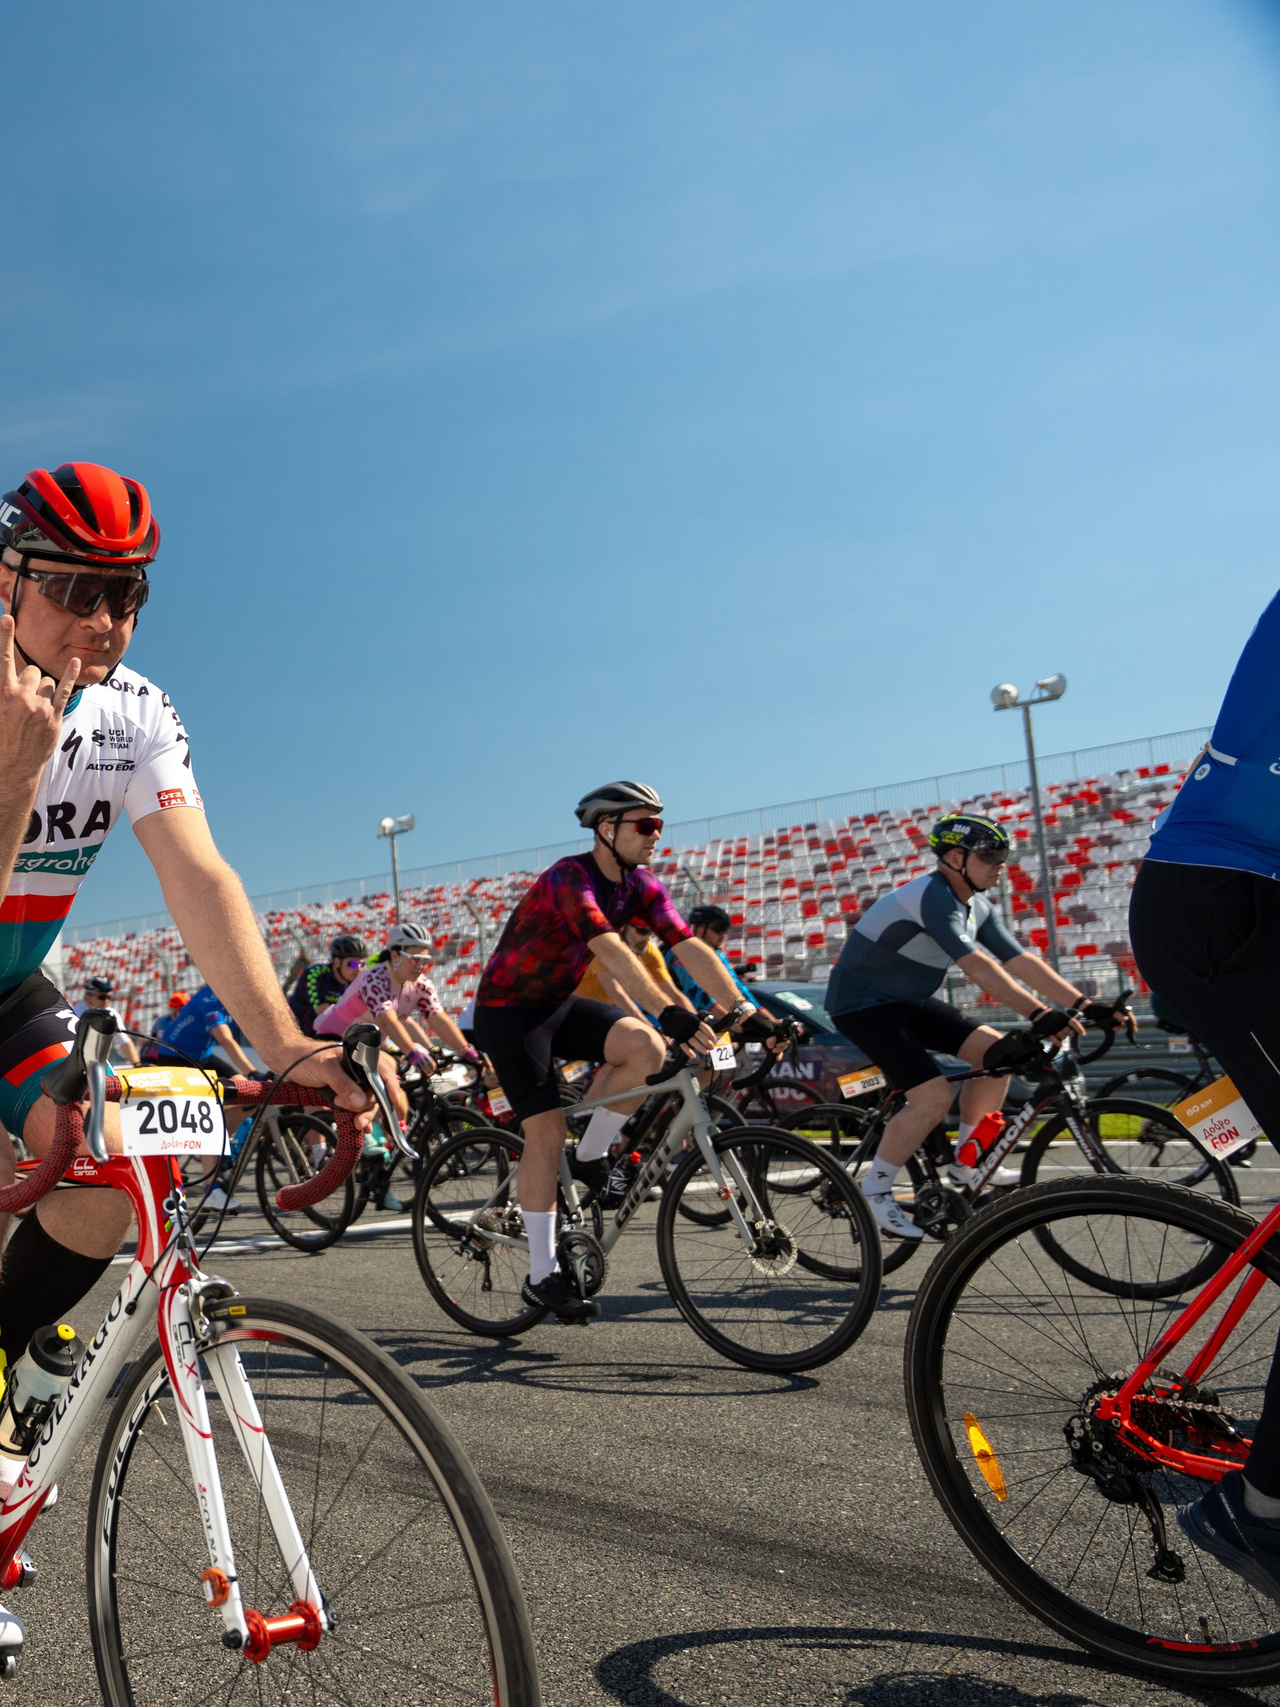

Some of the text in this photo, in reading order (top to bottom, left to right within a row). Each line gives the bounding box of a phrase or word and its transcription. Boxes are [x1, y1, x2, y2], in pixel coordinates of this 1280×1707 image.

[99, 678, 150, 697] ORA
[160, 791, 184, 800] ÖTZ
[162, 798, 185, 806] TAL
[21, 799, 111, 845] ORA
[136, 1099, 214, 1135] 2048
[1202, 1118, 1231, 1140] Добро
[968, 1101, 1035, 1192] Bianchi
[1210, 1125, 1240, 1150] FON
[73, 1157, 94, 1170] CL
[173, 1324, 183, 1368] carbon
[29, 1289, 123, 1467] COLNAGO
